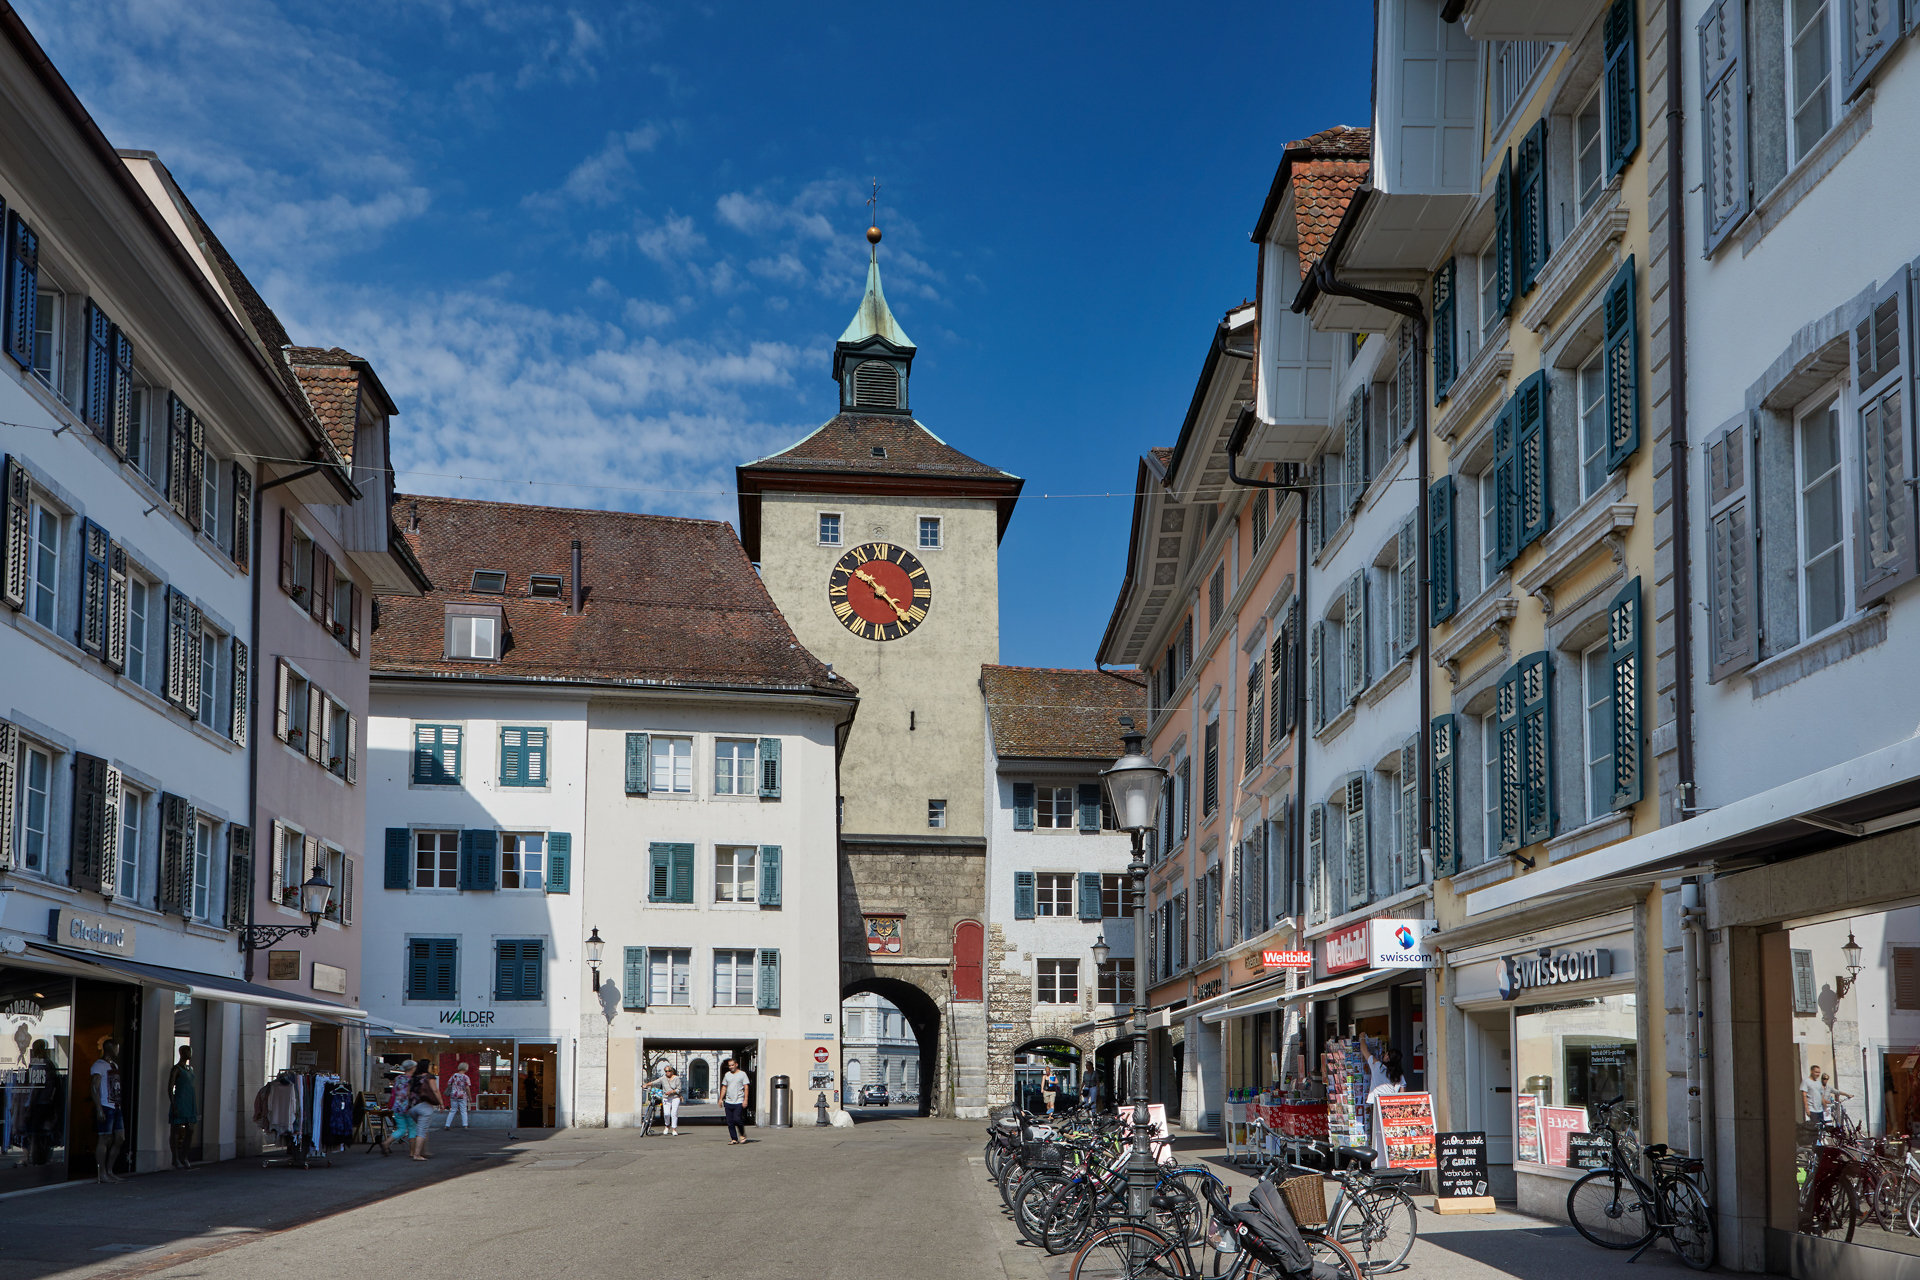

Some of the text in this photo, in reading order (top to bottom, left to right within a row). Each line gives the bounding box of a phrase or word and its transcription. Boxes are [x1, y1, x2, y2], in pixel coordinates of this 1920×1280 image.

[70, 918, 125, 948] Clochard
[1326, 928, 1367, 969] Weltbild
[1264, 952, 1311, 963] Weltbild
[1380, 952, 1432, 962] swisscom
[1513, 949, 1600, 990] swisscom
[5, 1000, 44, 1022] CLOCHARD
[440, 1008, 494, 1025] WALDER
[28, 1067, 46, 1084] Years
[1466, 1136, 1484, 1145] mobile
[1452, 1157, 1476, 1166] GERÄTE
[1444, 1169, 1473, 1177] verbunden
[1454, 1187, 1473, 1195] ABO
